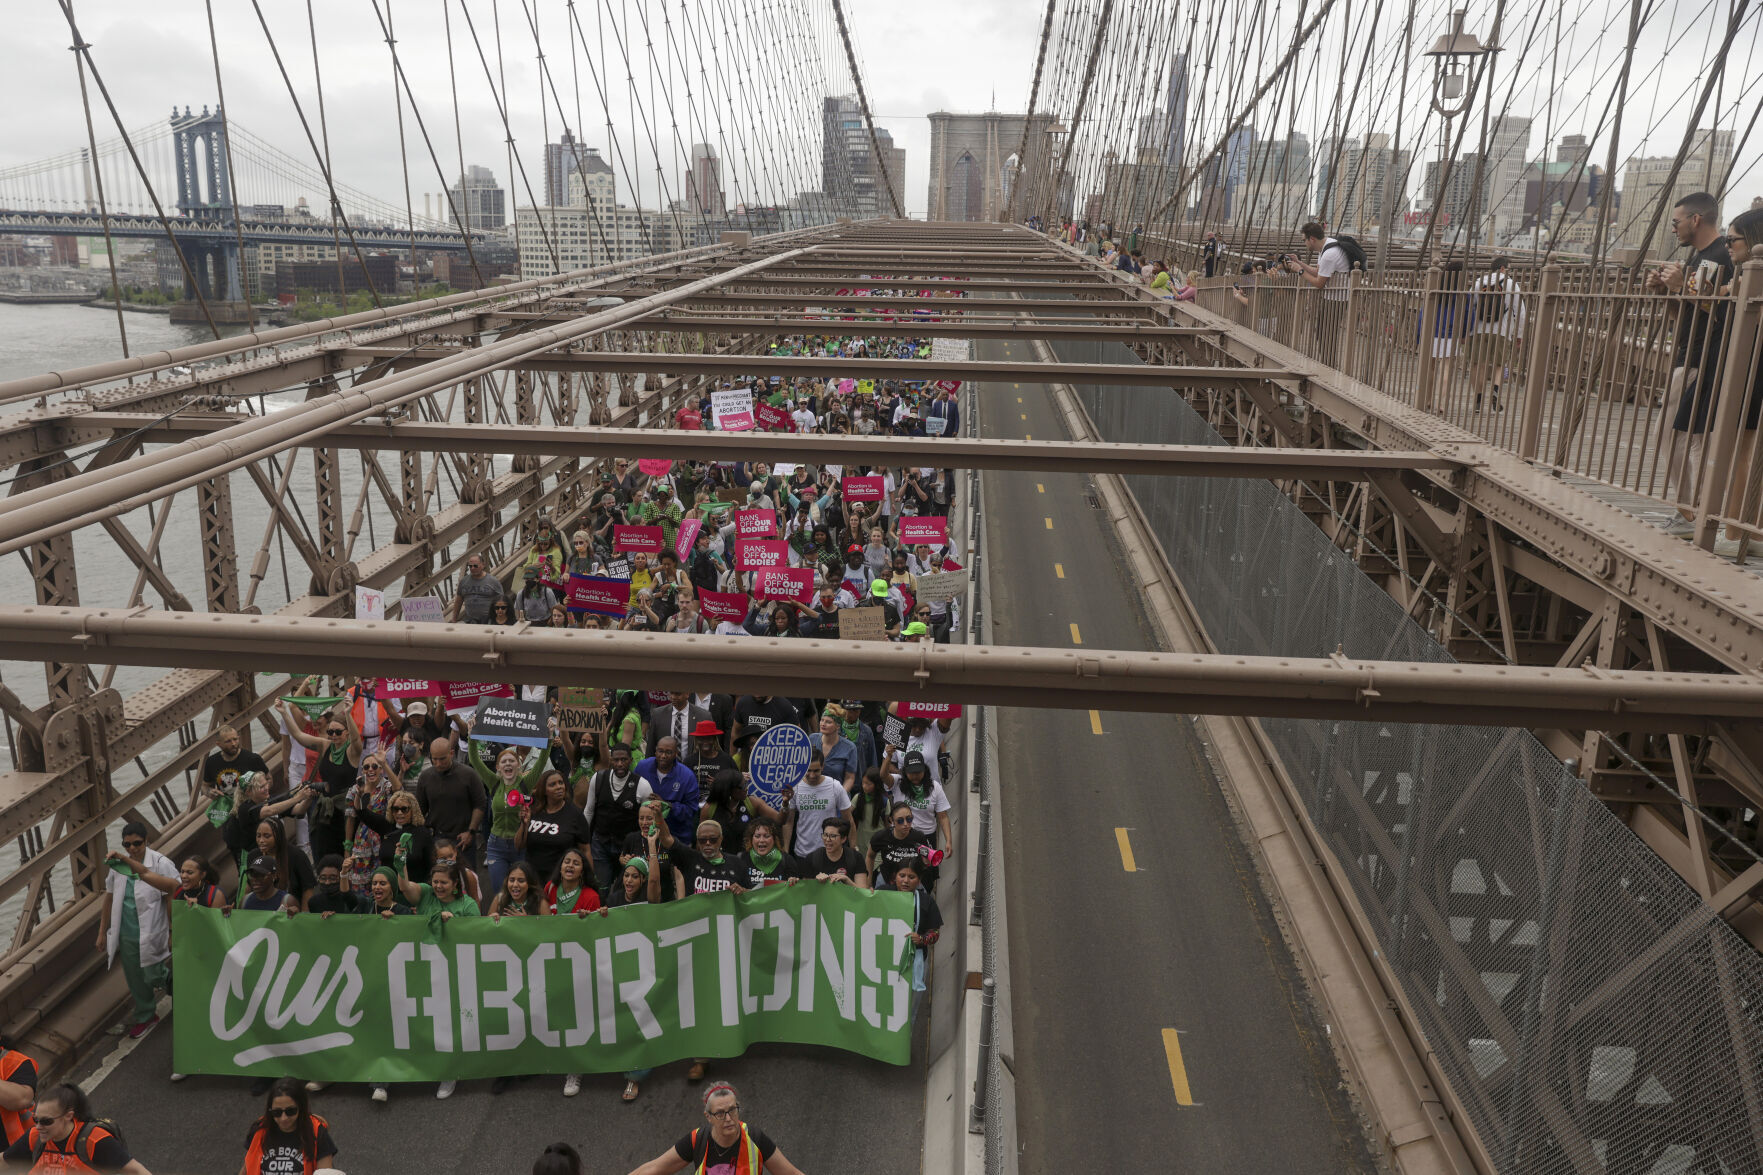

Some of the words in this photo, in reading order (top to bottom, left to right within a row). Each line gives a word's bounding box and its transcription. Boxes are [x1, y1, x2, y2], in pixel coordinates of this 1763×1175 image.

[719, 406, 747, 414] ABORTION
[740, 514, 759, 522] BANS
[740, 520, 754, 528] OFF
[740, 525, 770, 534] BODIES
[744, 545, 766, 553] BANS
[616, 565, 629, 574] OUR
[765, 572, 789, 581] BANS
[764, 579, 782, 587] OFF
[782, 580, 804, 589] OUR
[576, 587, 604, 596] Abortion
[764, 587, 800, 596] BODIES
[704, 597, 725, 607] Abortion
[704, 603, 723, 612] Health
[387, 681, 428, 692] BODIES
[450, 688, 479, 697] Health
[480, 683, 502, 691] Care.
[909, 702, 950, 712] BODIES
[485, 707, 527, 720] Abortion
[528, 712, 536, 721] is
[483, 716, 514, 728] Health
[516, 721, 540, 731] Care.
[749, 716, 770, 724] STAND
[766, 728, 804, 746] KEEP
[753, 746, 809, 765] ABORTION
[757, 764, 802, 784] LEGAL
[528, 820, 560, 835] 1973
[210, 928, 364, 1041] Our
[388, 904, 912, 1052] ABORTIONS
[269, 1161, 294, 1171] OUR
